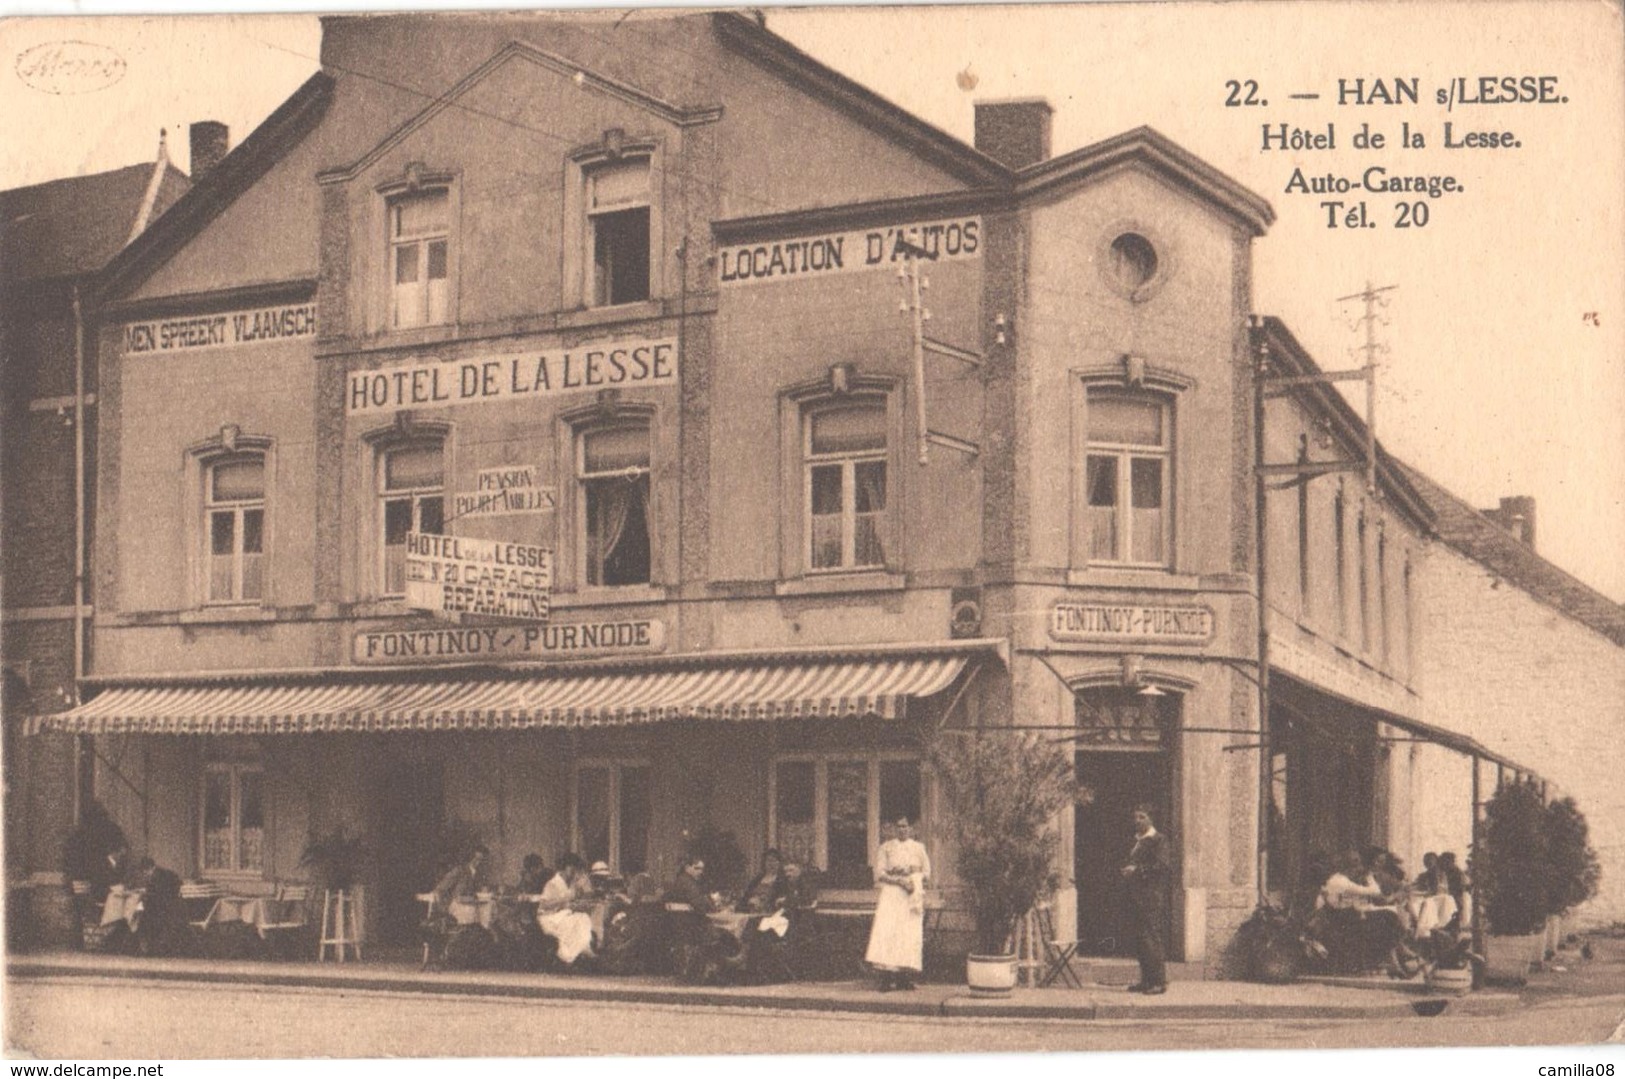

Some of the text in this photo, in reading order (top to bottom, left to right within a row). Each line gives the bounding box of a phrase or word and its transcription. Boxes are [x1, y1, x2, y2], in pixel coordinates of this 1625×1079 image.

[721, 237, 844, 281] LOCATION
[125, 306, 316, 351] MEN SPREEKT VLAAMSCH
[351, 344, 673, 409] HOTEL DE LA LESSE
[479, 469, 533, 490] PENSION
[407, 533, 464, 561] HOTEL
[464, 564, 549, 592] GARAGE
